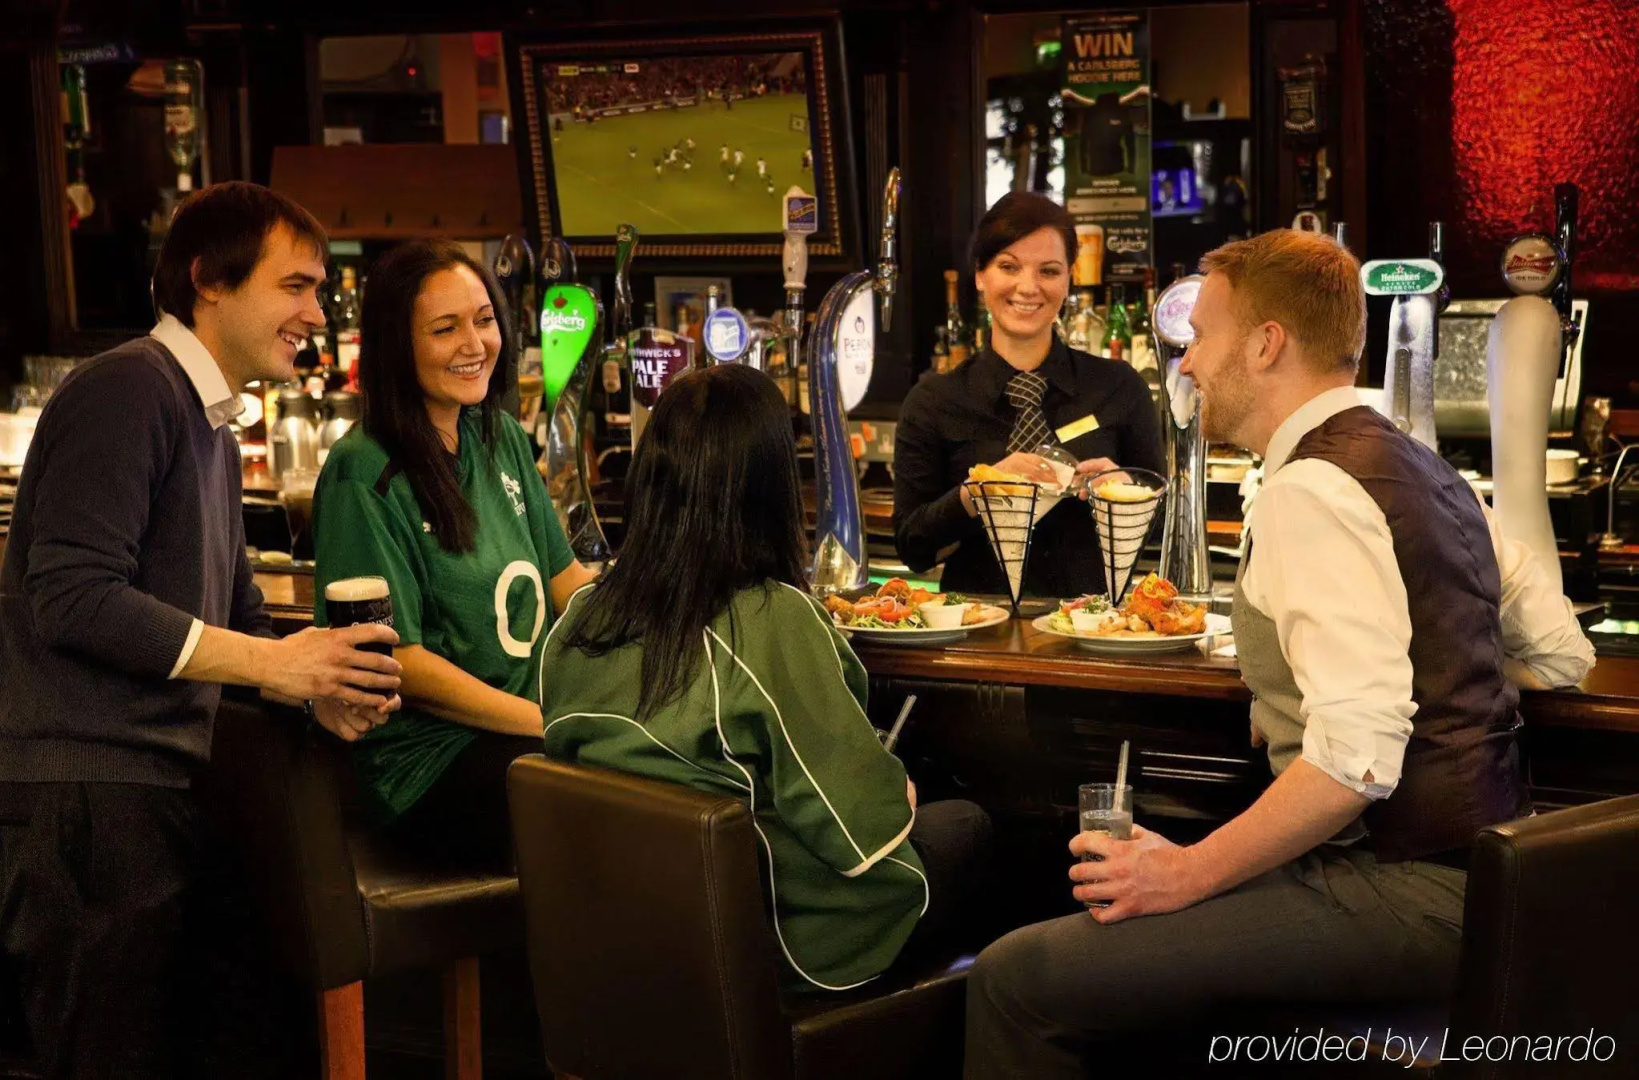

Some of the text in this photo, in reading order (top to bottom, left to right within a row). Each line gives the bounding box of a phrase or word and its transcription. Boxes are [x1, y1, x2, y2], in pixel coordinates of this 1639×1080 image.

[1074, 32, 1134, 58] WIN
[1112, 71, 1141, 82] HERE
[1381, 271, 1421, 282] Heineken
[631, 360, 669, 374] PALE
[636, 374, 663, 388] ALE
